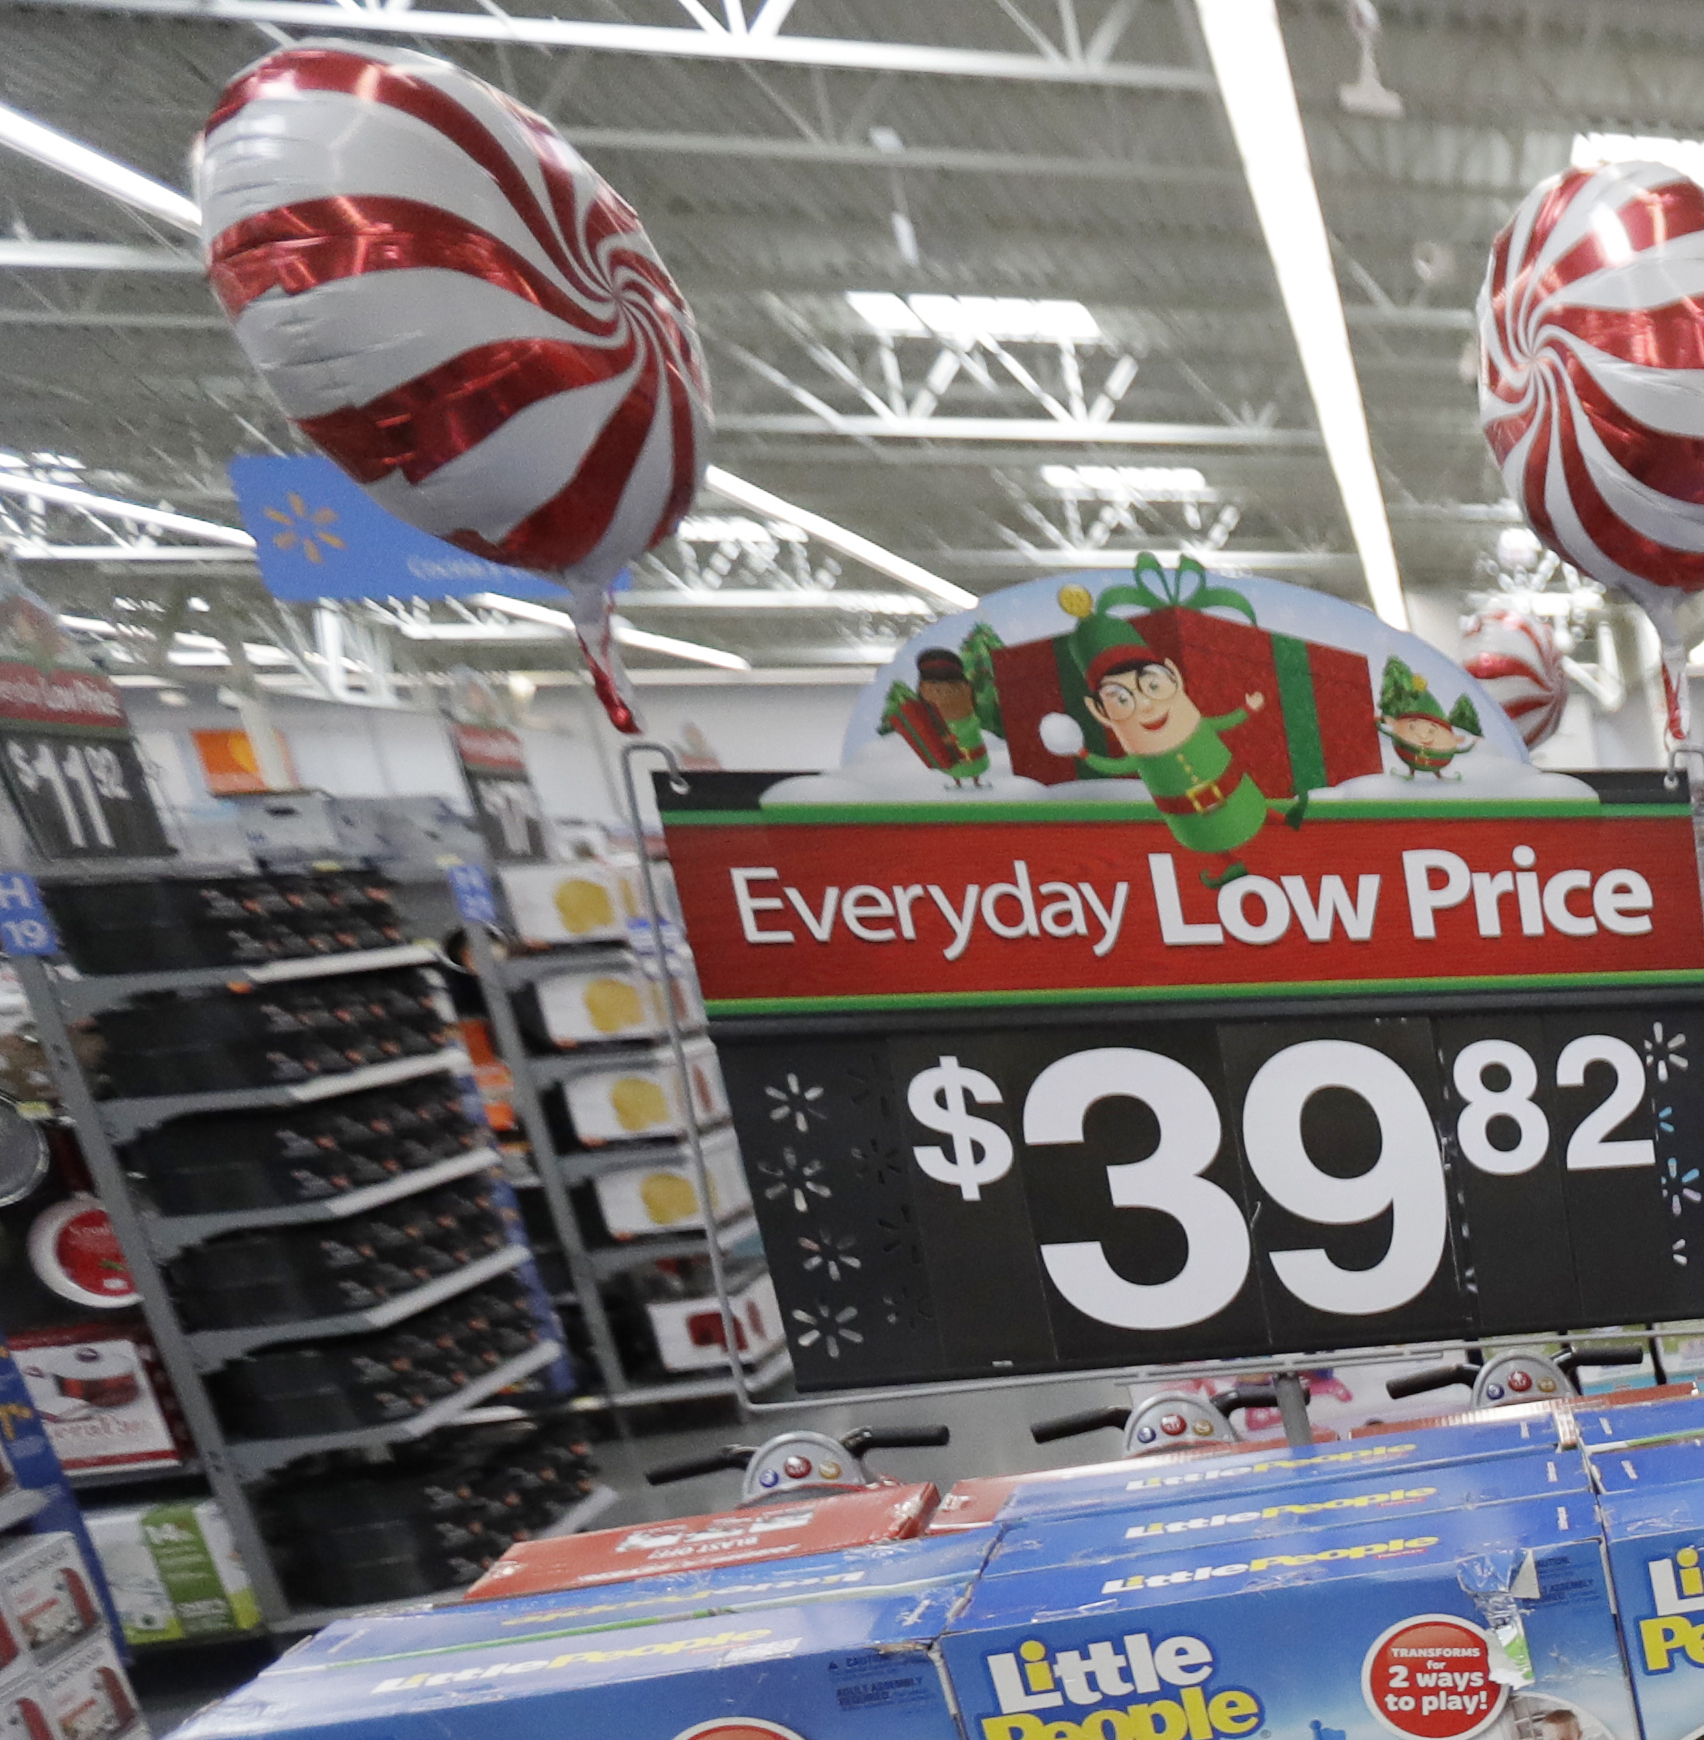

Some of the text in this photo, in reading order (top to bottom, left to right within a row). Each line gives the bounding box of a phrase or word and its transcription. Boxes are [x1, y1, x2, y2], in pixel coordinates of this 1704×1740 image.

[730, 845, 1654, 961] Everyday Low Price
[5, 919, 45, 949] 19
[1388, 1646, 1480, 1658] TRANSFORMS
[1424, 1659, 1446, 1671] for
[984, 1632, 1213, 1716] Little
[1386, 1663, 1485, 1692] 2 ways
[1383, 1688, 1488, 1716] to play!
